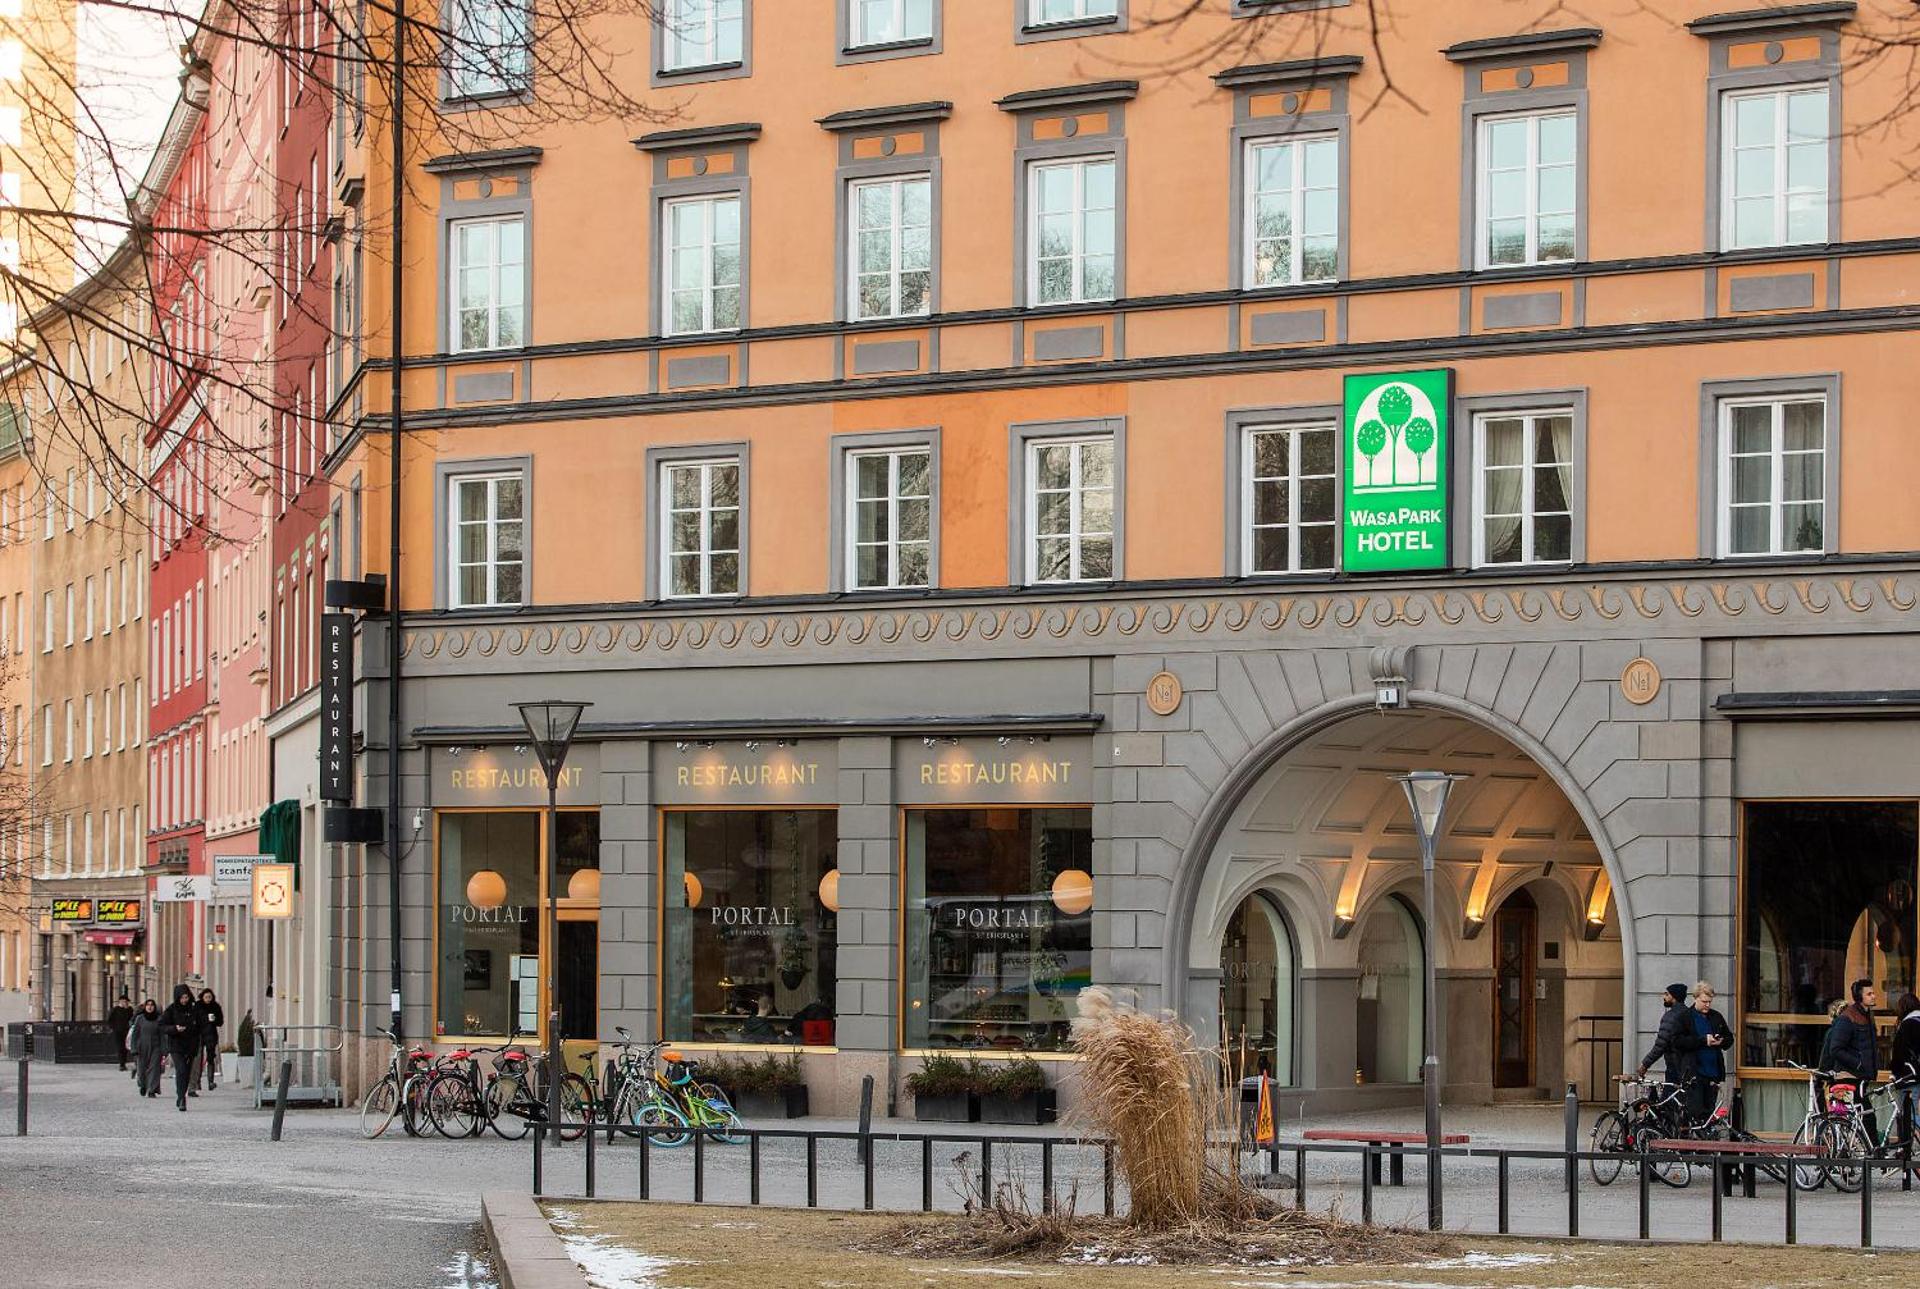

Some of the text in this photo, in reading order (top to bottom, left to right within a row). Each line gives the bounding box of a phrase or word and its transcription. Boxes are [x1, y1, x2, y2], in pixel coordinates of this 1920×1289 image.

[1357, 530, 1434, 553] HOTEL
[331, 625, 340, 788] RESTAURANT
[451, 767, 583, 788] RESTAURNT
[677, 764, 818, 786] RESTAURANT
[919, 762, 1071, 785] RESTAURANT
[452, 904, 528, 923] PORTAL
[711, 906, 795, 925] PORTAL
[955, 908, 1044, 928] PORTAL
